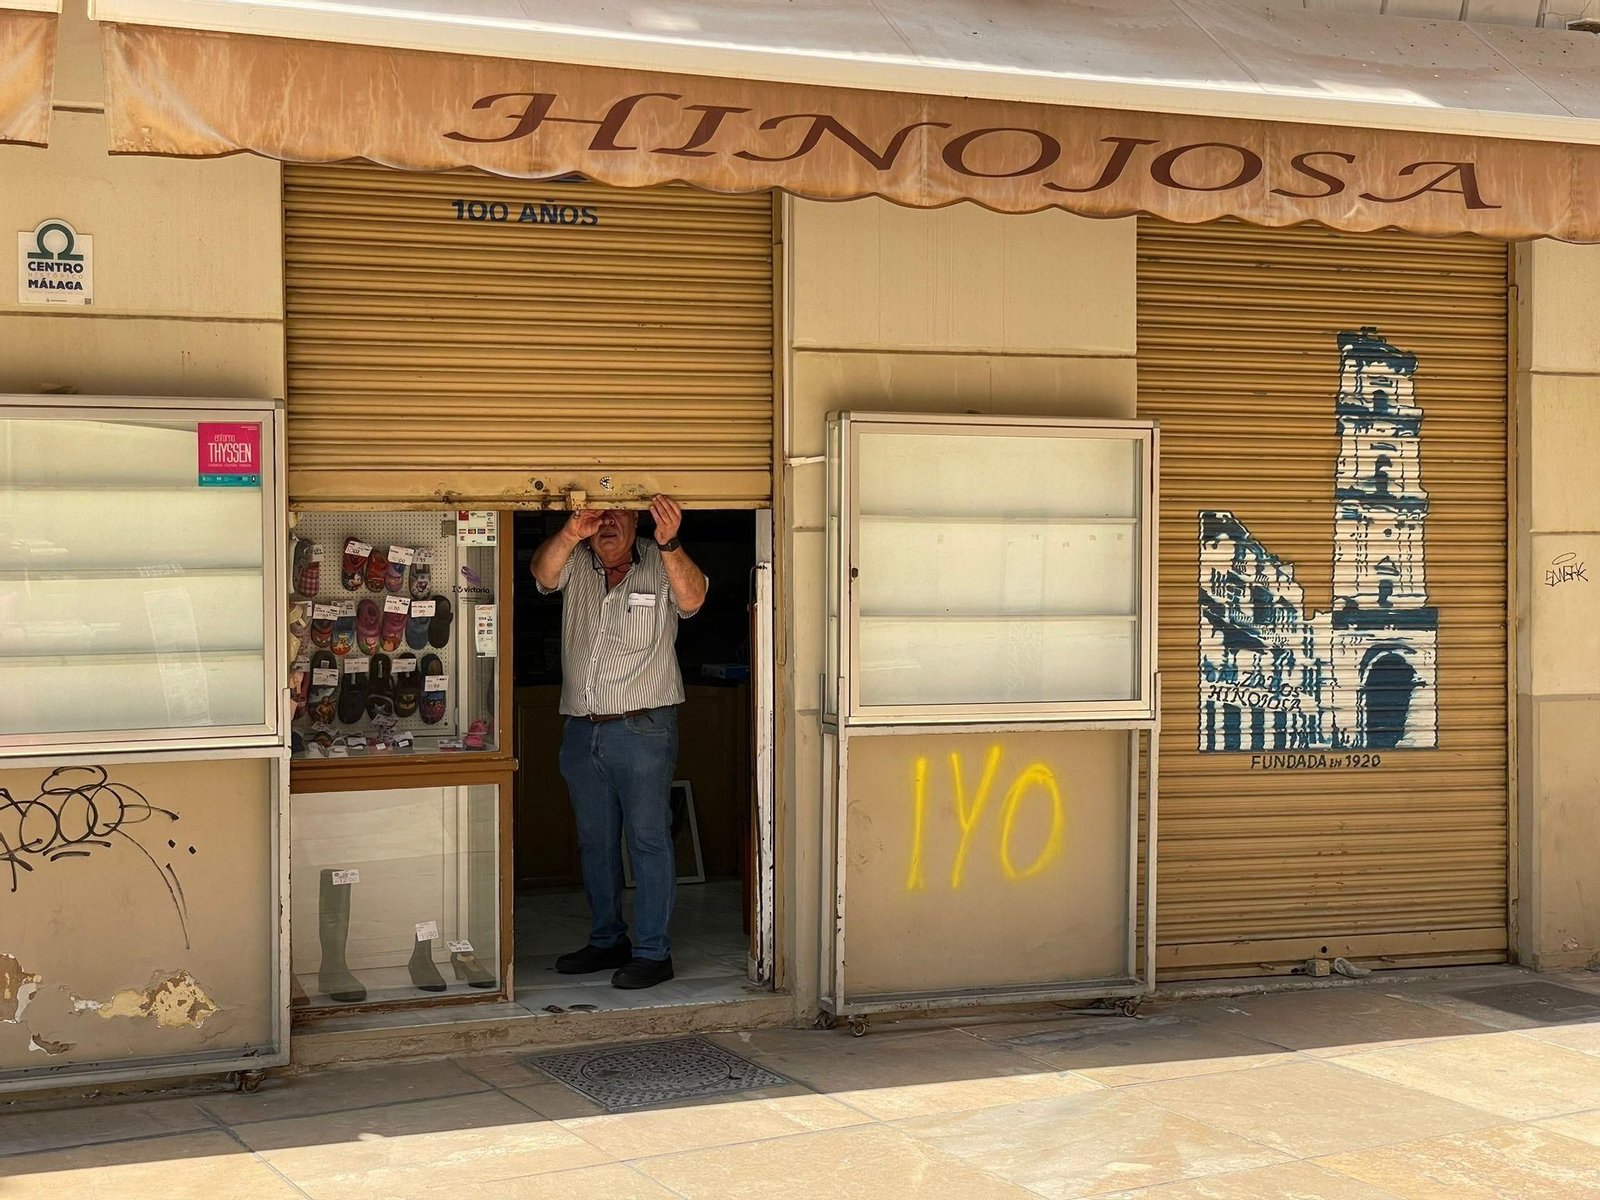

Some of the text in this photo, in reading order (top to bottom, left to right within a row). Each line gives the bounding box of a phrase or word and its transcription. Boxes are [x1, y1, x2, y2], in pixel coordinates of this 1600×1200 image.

[442, 92, 1502, 209] HINOJOSA
[452, 199, 599, 226] 100 AÑOS
[28, 261, 84, 274] CENTRO
[28, 278, 83, 290] MÁLAGA
[208, 443, 252, 463] THYSSEN
[464, 586, 490, 594] victoria
[1206, 667, 1303, 698] CALZADOS
[1250, 754, 1381, 769] FUNDADA EN 1920
